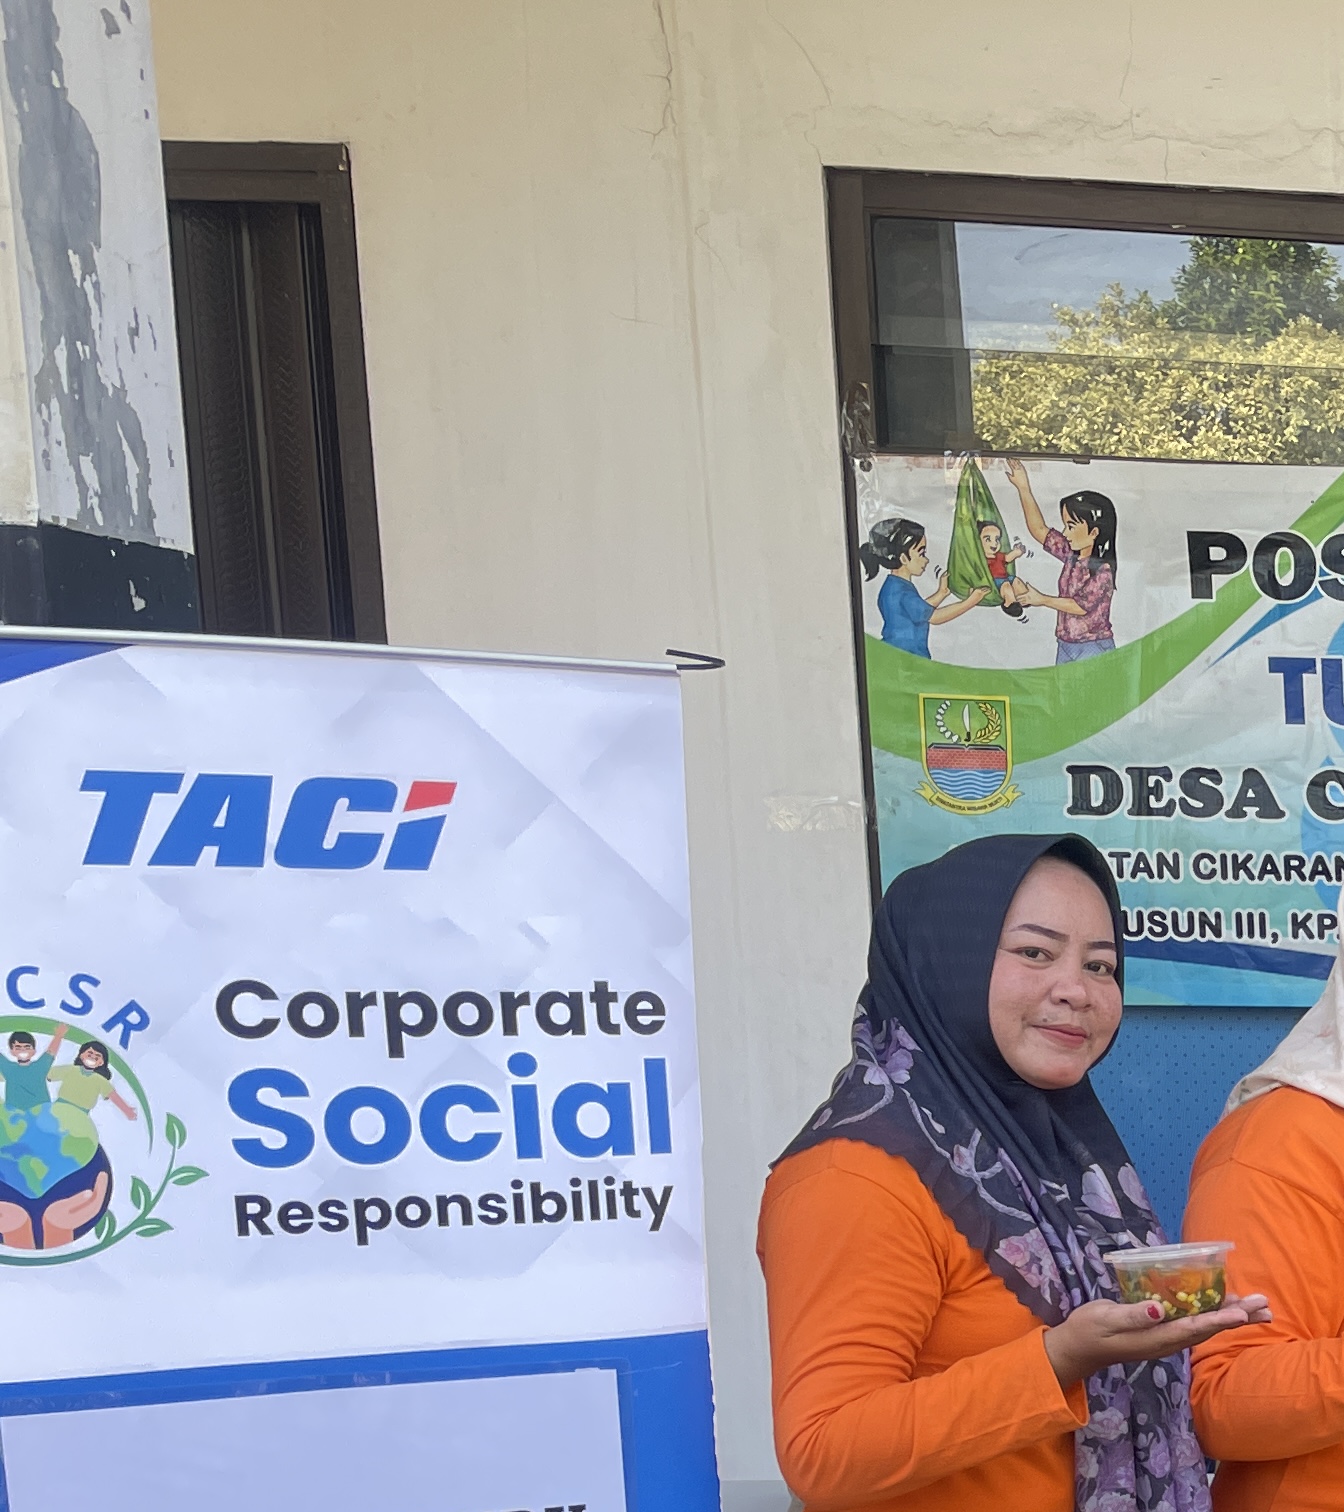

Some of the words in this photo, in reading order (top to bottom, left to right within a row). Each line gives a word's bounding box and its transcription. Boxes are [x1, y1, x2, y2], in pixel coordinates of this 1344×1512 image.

[1066, 765, 1285, 819] DESA
[1108, 852, 1180, 880] TAN
[1121, 910, 1222, 938] USUN
[216, 980, 666, 1059] Corporate
[227, 1052, 673, 1168] Social
[236, 1177, 674, 1245] Responsibility
